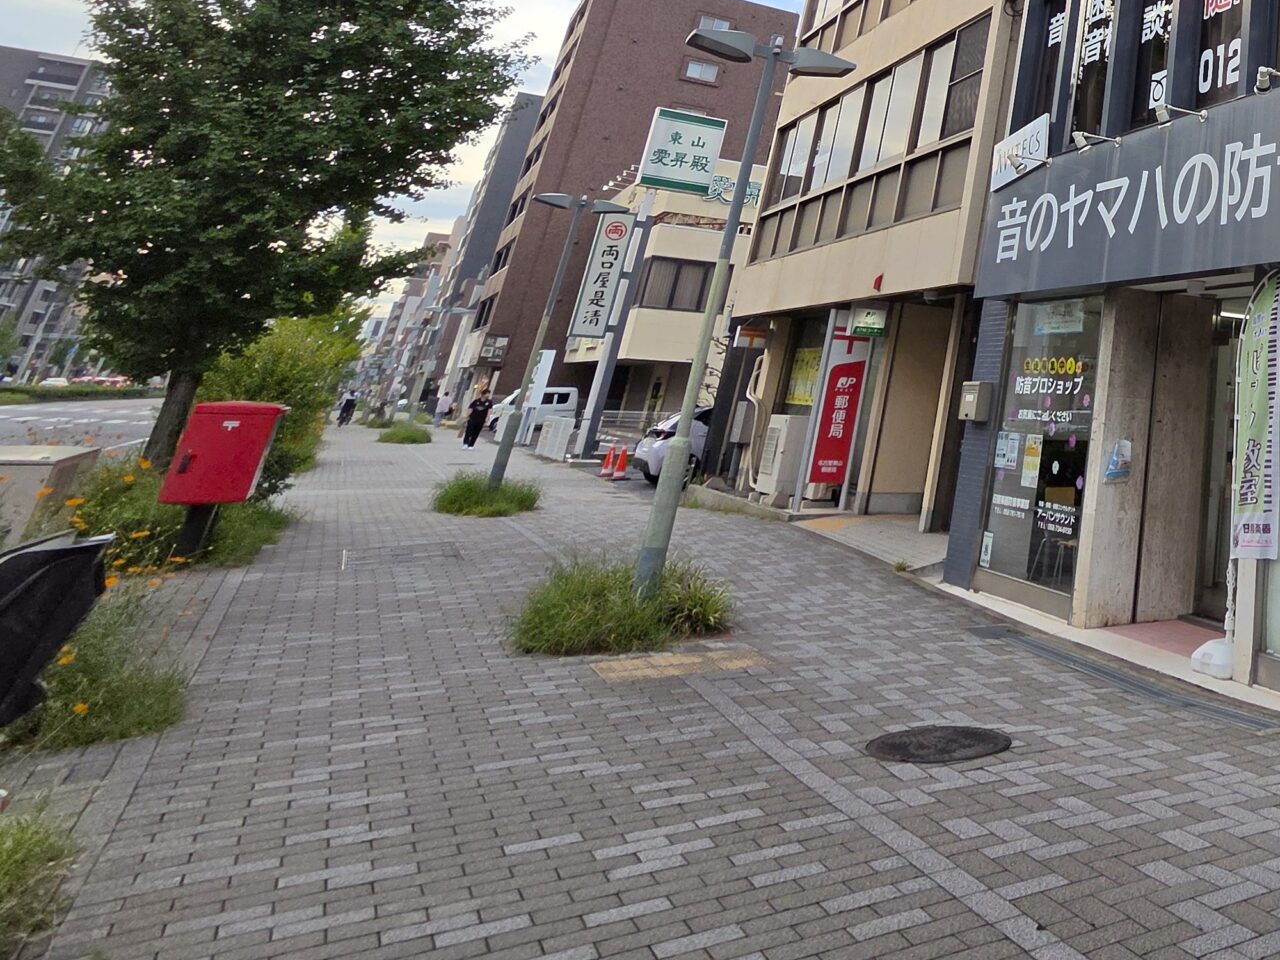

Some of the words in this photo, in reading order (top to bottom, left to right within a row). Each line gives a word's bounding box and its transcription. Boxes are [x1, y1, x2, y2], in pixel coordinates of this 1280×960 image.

[668, 130, 706, 149] 東山
[650, 148, 711, 173] 愛昇殿
[582, 245, 619, 327] 両口屋是清
[1015, 376, 1084, 395] 防音プロショップ
[828, 395, 849, 439] 郵便局
[1036, 508, 1076, 526] アーバンサウンド
